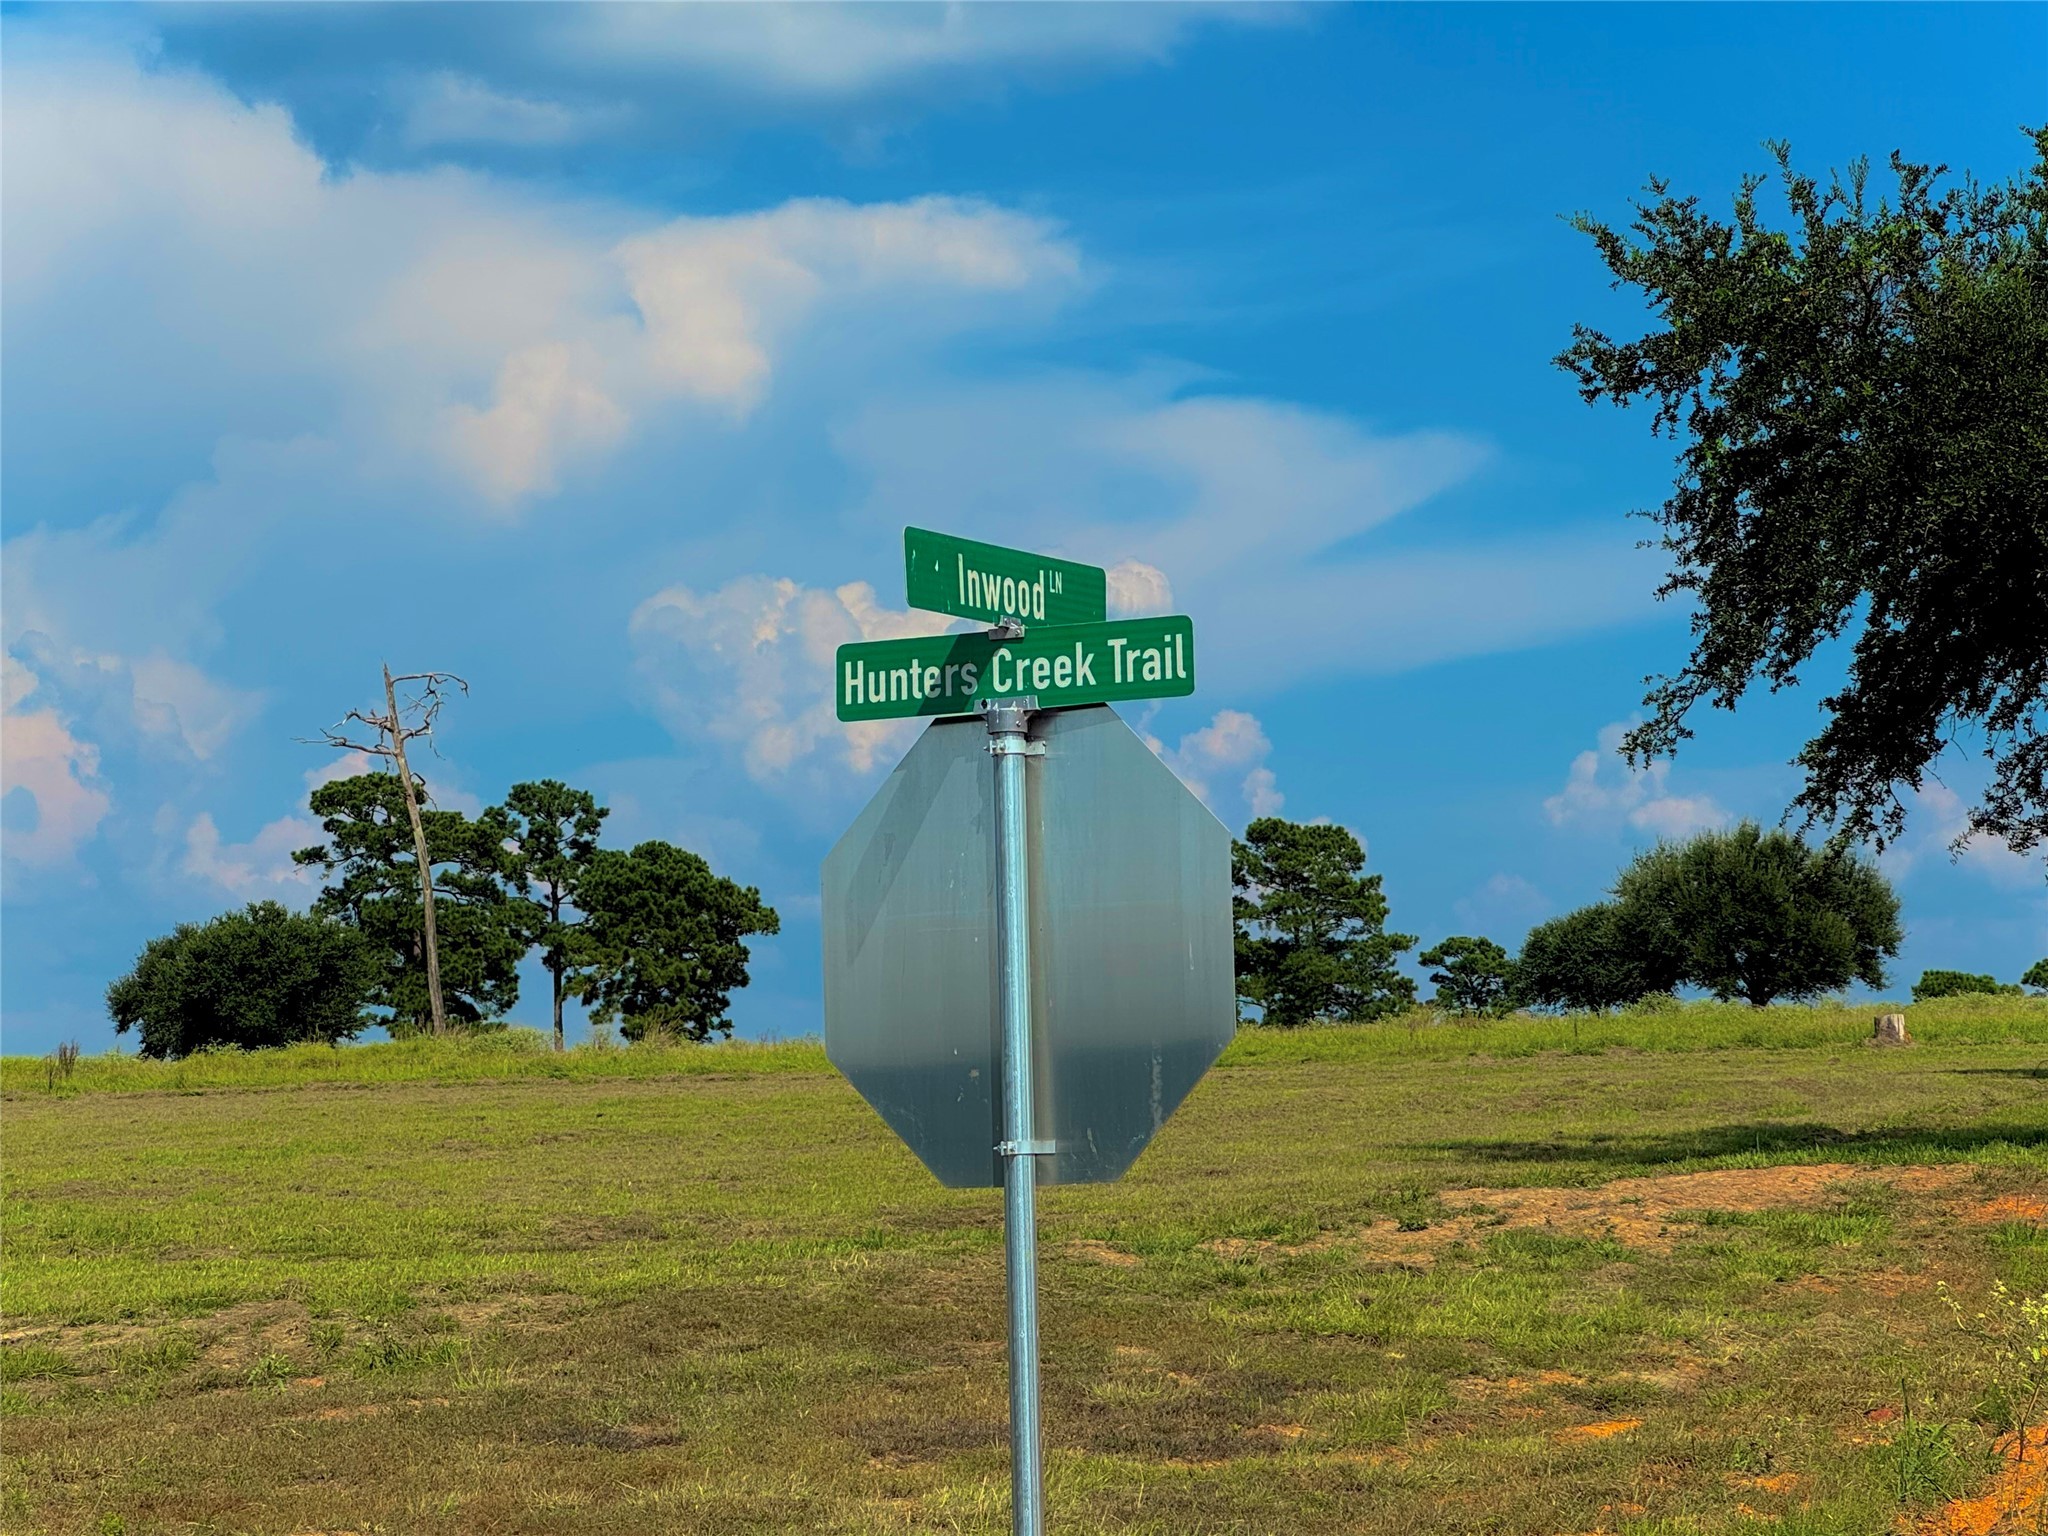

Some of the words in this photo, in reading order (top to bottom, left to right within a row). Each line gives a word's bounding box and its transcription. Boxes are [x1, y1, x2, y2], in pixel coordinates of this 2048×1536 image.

[957, 553, 1046, 621] Inwood
[1049, 569, 1064, 596] LN
[844, 658, 978, 706] Hunters
[992, 641, 1097, 693] Creek
[1107, 633, 1187, 684] Trail
